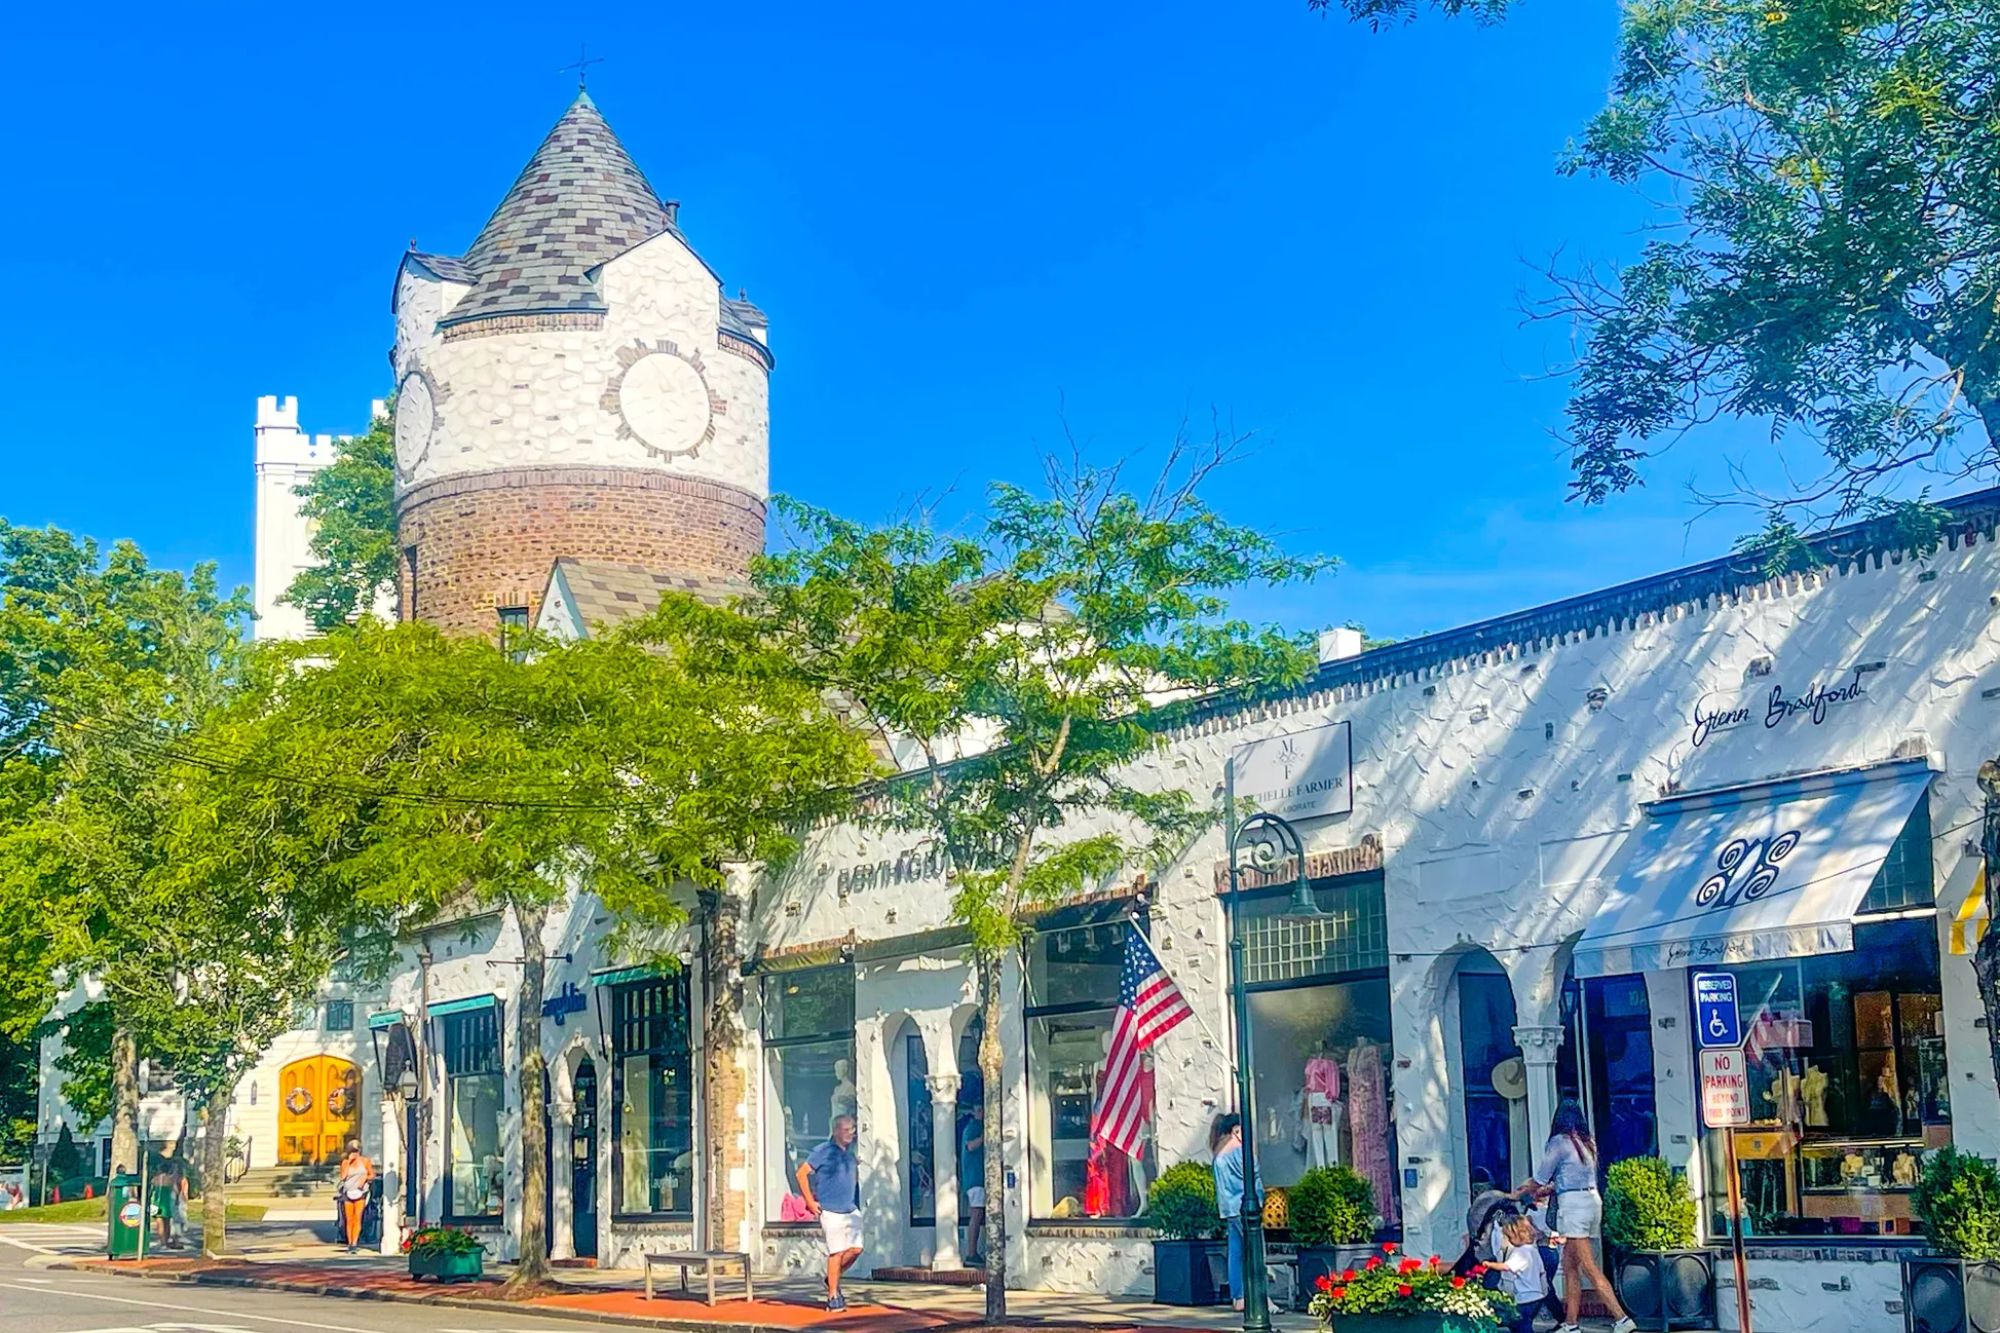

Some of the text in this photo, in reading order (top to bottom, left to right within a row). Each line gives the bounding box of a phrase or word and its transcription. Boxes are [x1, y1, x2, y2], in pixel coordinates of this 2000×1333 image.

[1764, 673, 1865, 729] Bradford
[1296, 777, 1343, 796] FARMER
[1698, 980, 1733, 991] RESERVED
[1699, 992, 1733, 1003] PARKING
[1714, 1056, 1731, 1071] NO
[1705, 1074, 1744, 1090] PARKING
[1712, 1093, 1739, 1104] BEYOND
[1726, 1106, 1745, 1118] POINT
